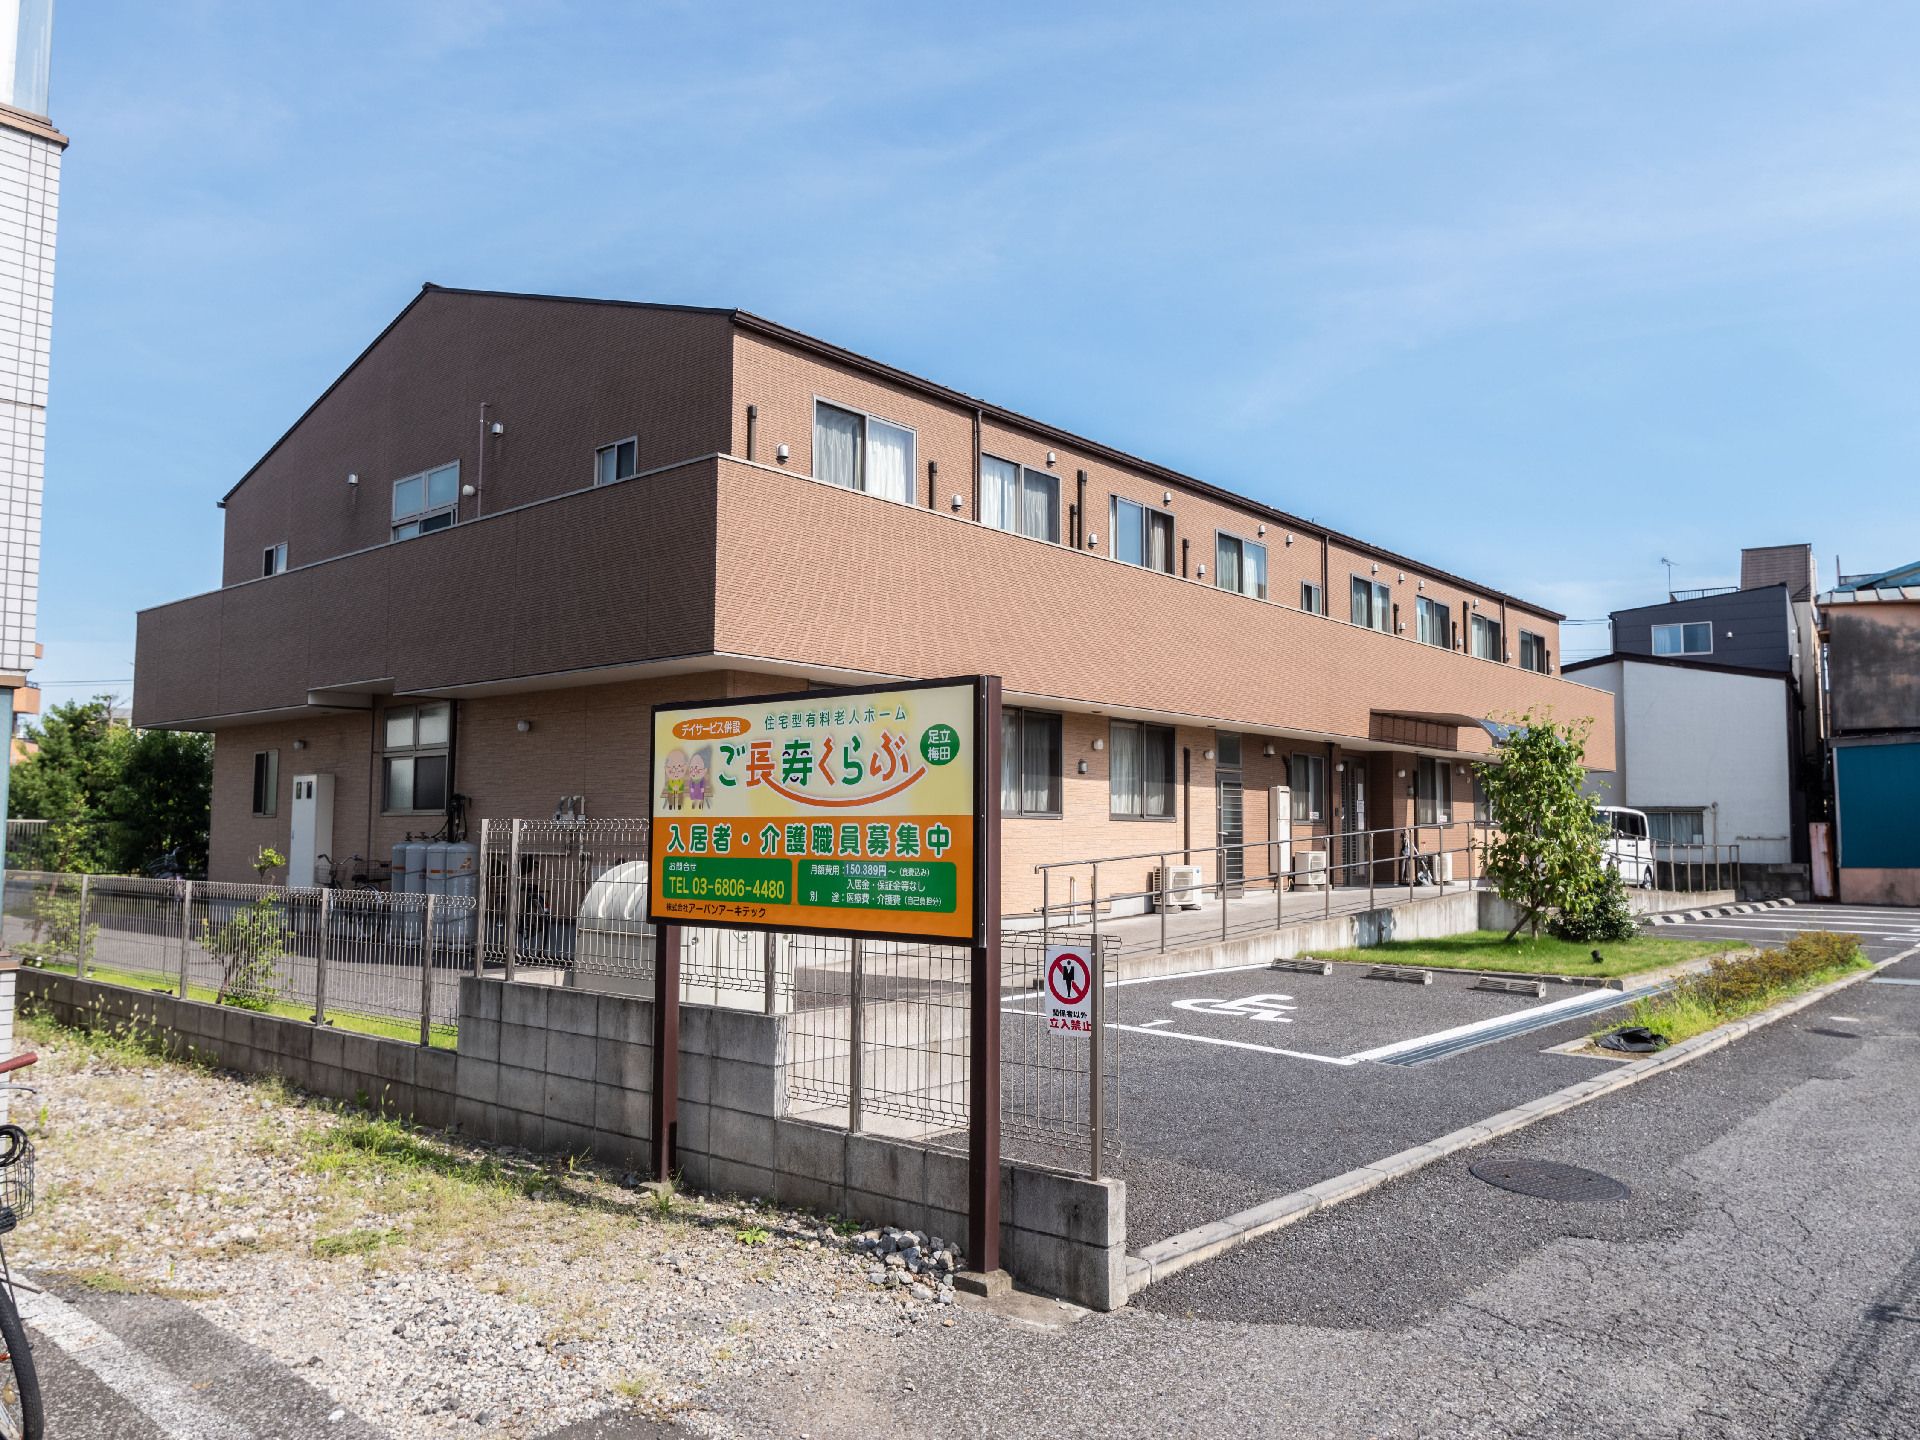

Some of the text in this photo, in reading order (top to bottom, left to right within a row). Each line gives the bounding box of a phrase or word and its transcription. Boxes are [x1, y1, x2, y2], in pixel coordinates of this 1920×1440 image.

[765, 706, 906, 730] 住宅型有料老人ホーム
[681, 720, 741, 737] デイサービス併設
[928, 729, 951, 744] 足立
[718, 731, 910, 787] ご長寿くらぶ
[928, 746, 950, 761] 梅田
[667, 822, 952, 858] 入居者・介護職員募集中
[669, 862, 697, 872] お問合せ
[668, 876, 785, 899] TEL 03-6806-4480
[666, 902, 766, 918] 株式会社アーバンアーキテック
[1052, 1008, 1087, 1019] 関係者以外
[1049, 1018, 1092, 1032] 立入禁止
